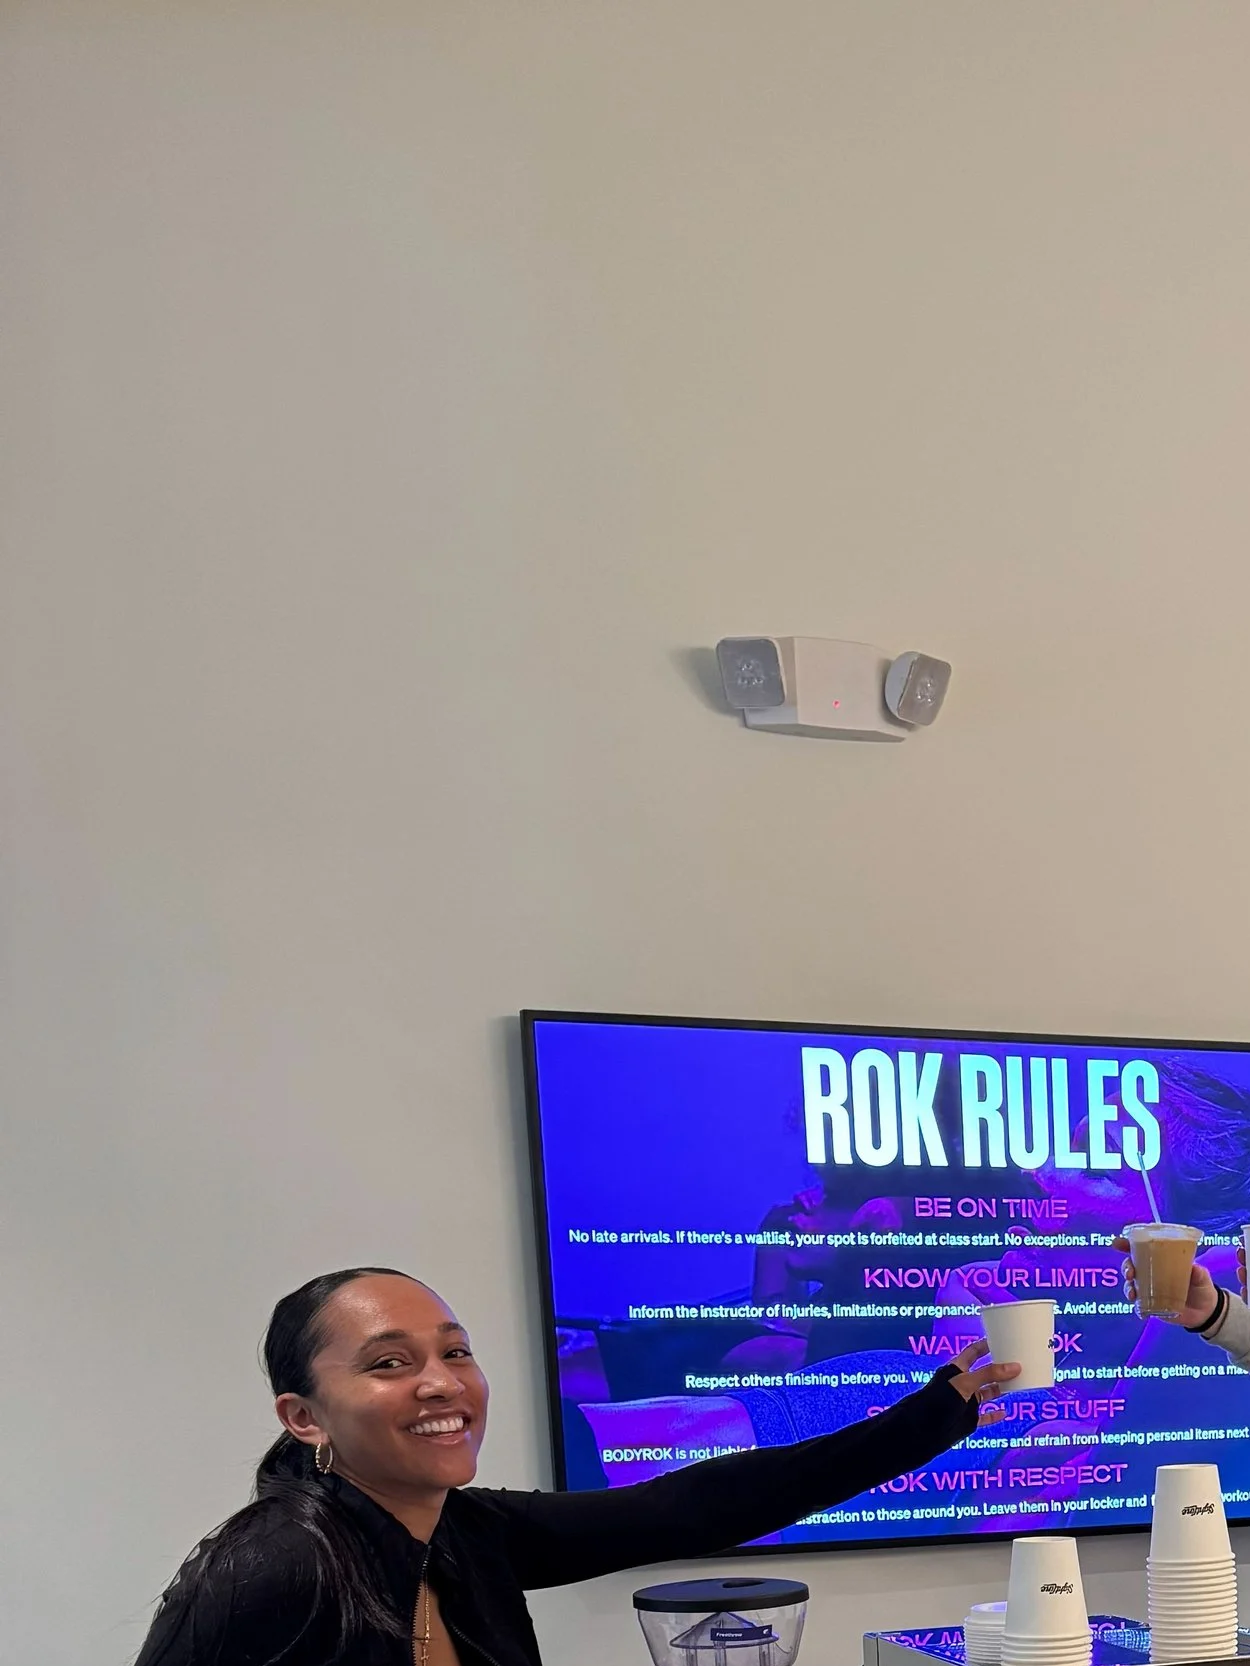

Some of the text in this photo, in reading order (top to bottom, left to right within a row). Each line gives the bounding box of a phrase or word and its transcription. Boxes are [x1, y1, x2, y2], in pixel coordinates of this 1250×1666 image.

[801, 1046, 1161, 1171] ROK RULES
[914, 1197, 1069, 1219] BE ON TIME
[568, 1229, 589, 1243] No
[592, 1229, 618, 1243] late
[620, 1230, 673, 1244] arrivals.
[675, 1230, 686, 1243] If
[687, 1230, 732, 1244] there's
[735, 1234, 743, 1244] a
[745, 1231, 794, 1247] waitlist,
[796, 1234, 825, 1248] your
[827, 1233, 856, 1247] spot
[858, 1232, 868, 1245] is
[870, 1232, 922, 1246] forfeited
[924, 1234, 938, 1245] at
[939, 1232, 970, 1245] class
[972, 1233, 1003, 1246] start.
[1004, 1233, 1022, 1246] No
[1024, 1233, 1089, 1248] exceptions.
[1090, 1232, 1114, 1246] First
[1204, 1233, 1231, 1246] mins
[864, 1267, 1118, 1288] KNOW YOUR LIMITS
[628, 1304, 674, 1319] Inform
[675, 1304, 698, 1318] the
[700, 1304, 764, 1318] instructor
[766, 1304, 780, 1317] of
[781, 1304, 831, 1320] injuries,
[833, 1303, 898, 1318] limitations
[899, 1307, 913, 1318] or
[914, 1303, 982, 1319] pregnanci
[1064, 1301, 1097, 1315] Avoid
[1098, 1302, 1134, 1315] center
[1051, 1333, 1083, 1353] OK
[685, 1373, 739, 1390] Respect
[741, 1373, 783, 1387] others
[785, 1373, 838, 1388] finishing
[841, 1371, 881, 1385] before
[883, 1372, 908, 1386] you.
[911, 1370, 936, 1384] Wai
[1053, 1366, 1081, 1382] ignal
[1082, 1366, 1095, 1379] to
[1096, 1365, 1123, 1379] start
[1124, 1364, 1160, 1378] before
[1161, 1363, 1201, 1379] getting
[1202, 1364, 1216, 1376] on
[1217, 1364, 1225, 1376] a
[980, 1398, 1125, 1421] UR STUFF
[602, 1447, 673, 1463] BODYROK
[675, 1447, 687, 1461] is
[689, 1448, 711, 1461] not
[713, 1445, 748, 1458] liab
[966, 1436, 1008, 1450] lockers
[1009, 1435, 1032, 1448] and
[1034, 1432, 1071, 1447] refrain
[1072, 1432, 1099, 1446] from
[1100, 1430, 1145, 1446] keeping
[1146, 1428, 1194, 1444] personal
[1195, 1427, 1225, 1440] items
[1226, 1426, 1250, 1439] next
[932, 1467, 1002, 1490] WITH
[1009, 1463, 1128, 1487] RESPECT
[796, 1510, 860, 1525] straction
[861, 1509, 875, 1522] to
[877, 1507, 911, 1521] those
[912, 1504, 955, 1519] around
[956, 1505, 981, 1521] you.
[983, 1502, 1017, 1516] Leave
[1018, 1499, 1049, 1513] them
[1051, 1499, 1061, 1512] in
[1062, 1500, 1089, 1515] your
[1089, 1497, 1124, 1512] locker
[1126, 1494, 1147, 1507] and
